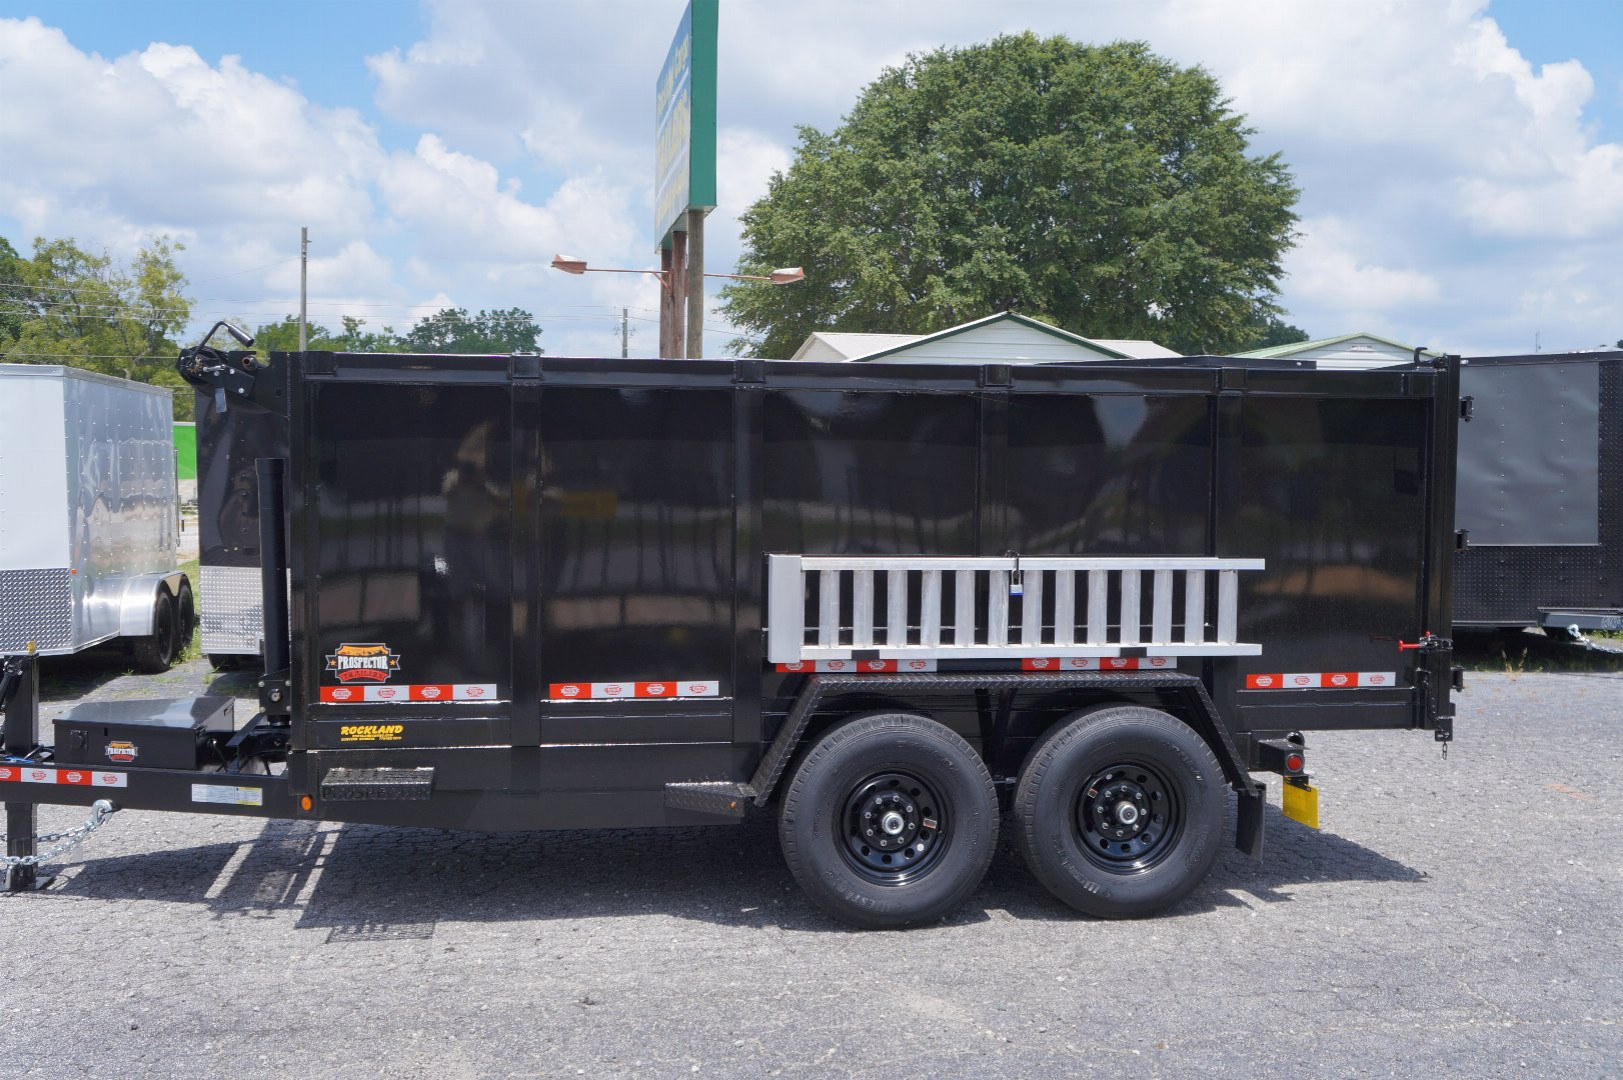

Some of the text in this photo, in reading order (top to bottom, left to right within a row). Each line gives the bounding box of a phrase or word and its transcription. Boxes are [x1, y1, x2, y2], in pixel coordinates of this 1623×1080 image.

[337, 655, 389, 670] PROSPECTOR
[342, 670, 384, 680] TRAILERS
[340, 724, 404, 735] ROCKLAND
